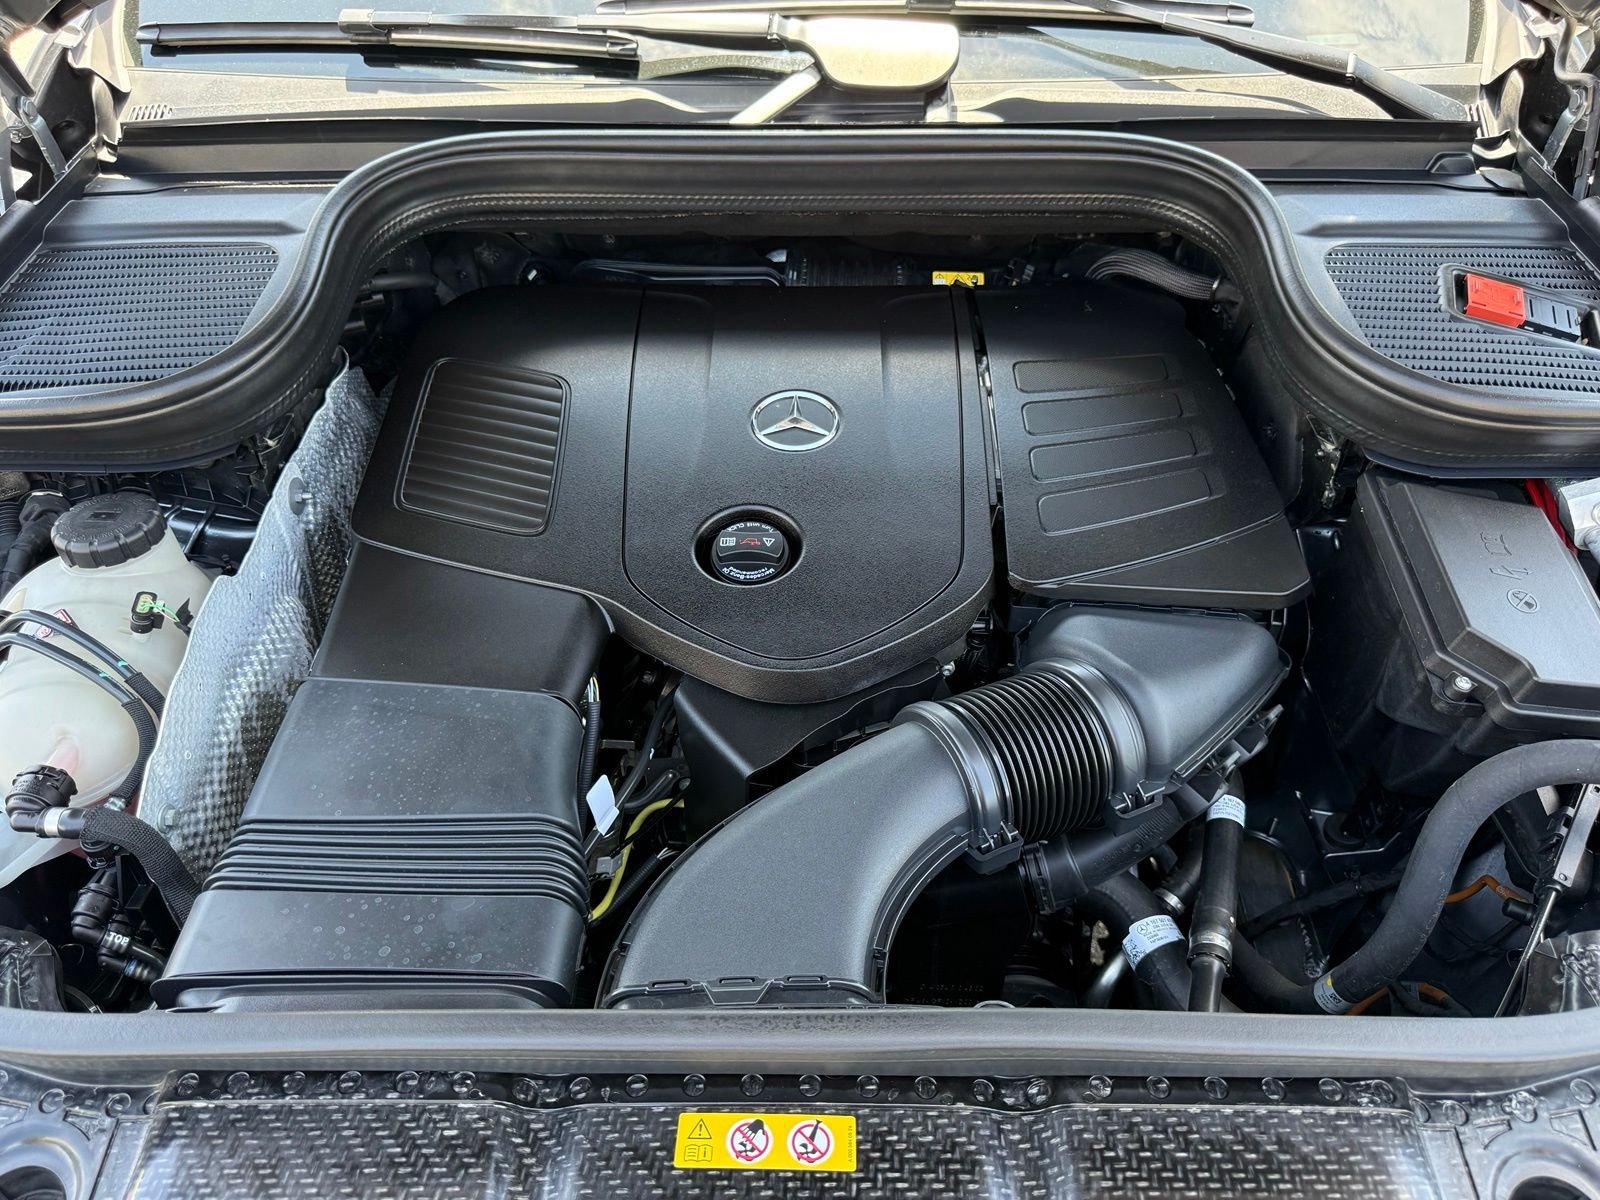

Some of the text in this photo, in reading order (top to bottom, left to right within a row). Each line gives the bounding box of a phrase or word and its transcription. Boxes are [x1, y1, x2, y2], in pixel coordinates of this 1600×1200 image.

[728, 566, 768, 575] recommended
[730, 568, 775, 579] Mercedes-Benz
[109, 931, 130, 944] TOP
